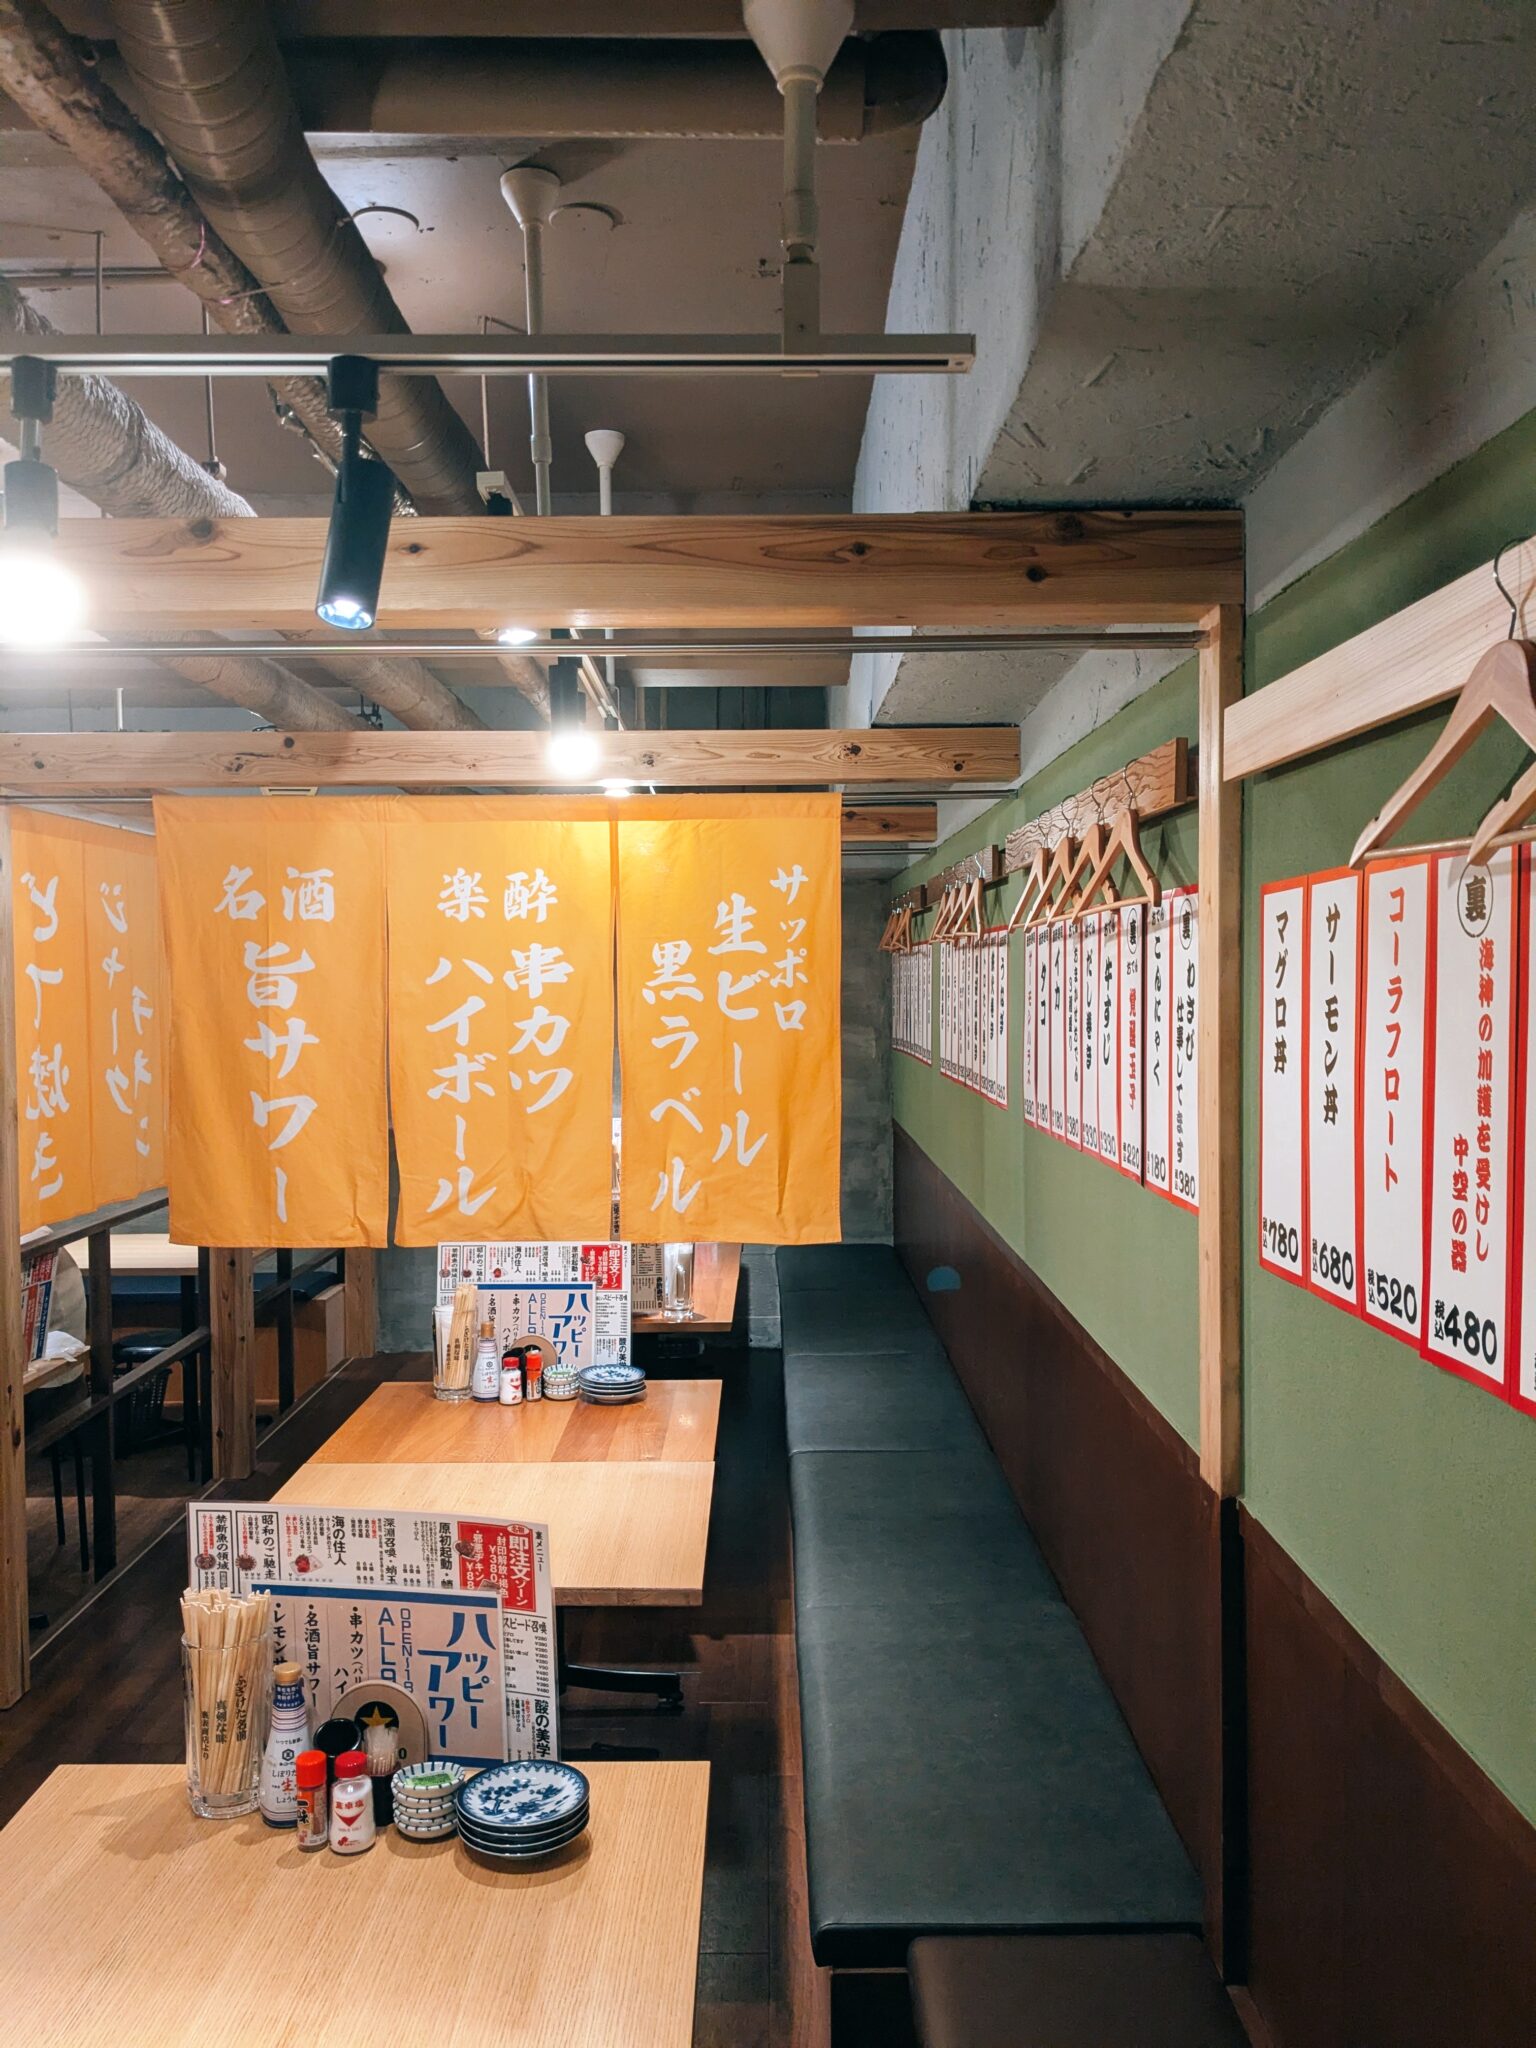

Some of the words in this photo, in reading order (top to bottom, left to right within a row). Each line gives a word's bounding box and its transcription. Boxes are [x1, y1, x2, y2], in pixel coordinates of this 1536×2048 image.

[1465, 876, 1487, 923] 裏
[770, 864, 808, 1031] サッポロ
[708, 893, 769, 1167] 生ビール
[1040, 962, 1047, 1027] タコ
[1103, 956, 1113, 1066] 牛すじ
[1153, 936, 1162, 1087] こんにゃく
[1186, 959, 1196, 1062] わさび
[1273, 910, 1290, 1076] マグロ丼
[1323, 902, 1341, 1127] サーモン丼
[642, 940, 704, 1213] 黒ラベル
[1384, 886, 1405, 1193] コーラフロート
[1475, 936, 1494, 1262] 海神の加護を受けし
[1151, 1152, 1166, 1183] 180
[1179, 1170, 1196, 1200] 380
[1451, 1134, 1470, 1273] 中空の器
[1268, 1220, 1298, 1263] 780
[1318, 1242, 1354, 1290] 680
[564, 1293, 591, 1357] ハッピー
[1375, 1272, 1417, 1325] 520
[1444, 1304, 1498, 1366] 480
[216, 1515, 230, 1570] 禁断魚の領域
[261, 1514, 276, 1580] 昭和のご馳走
[332, 1515, 347, 1566] 海の住人
[304, 1611, 321, 1708] 名酒旨サワー
[417, 1649, 462, 1748] アワー
[446, 1611, 497, 1729] ハッピー
[535, 1699, 551, 1758] 酸の美学
[281, 1778, 294, 1792] 生
